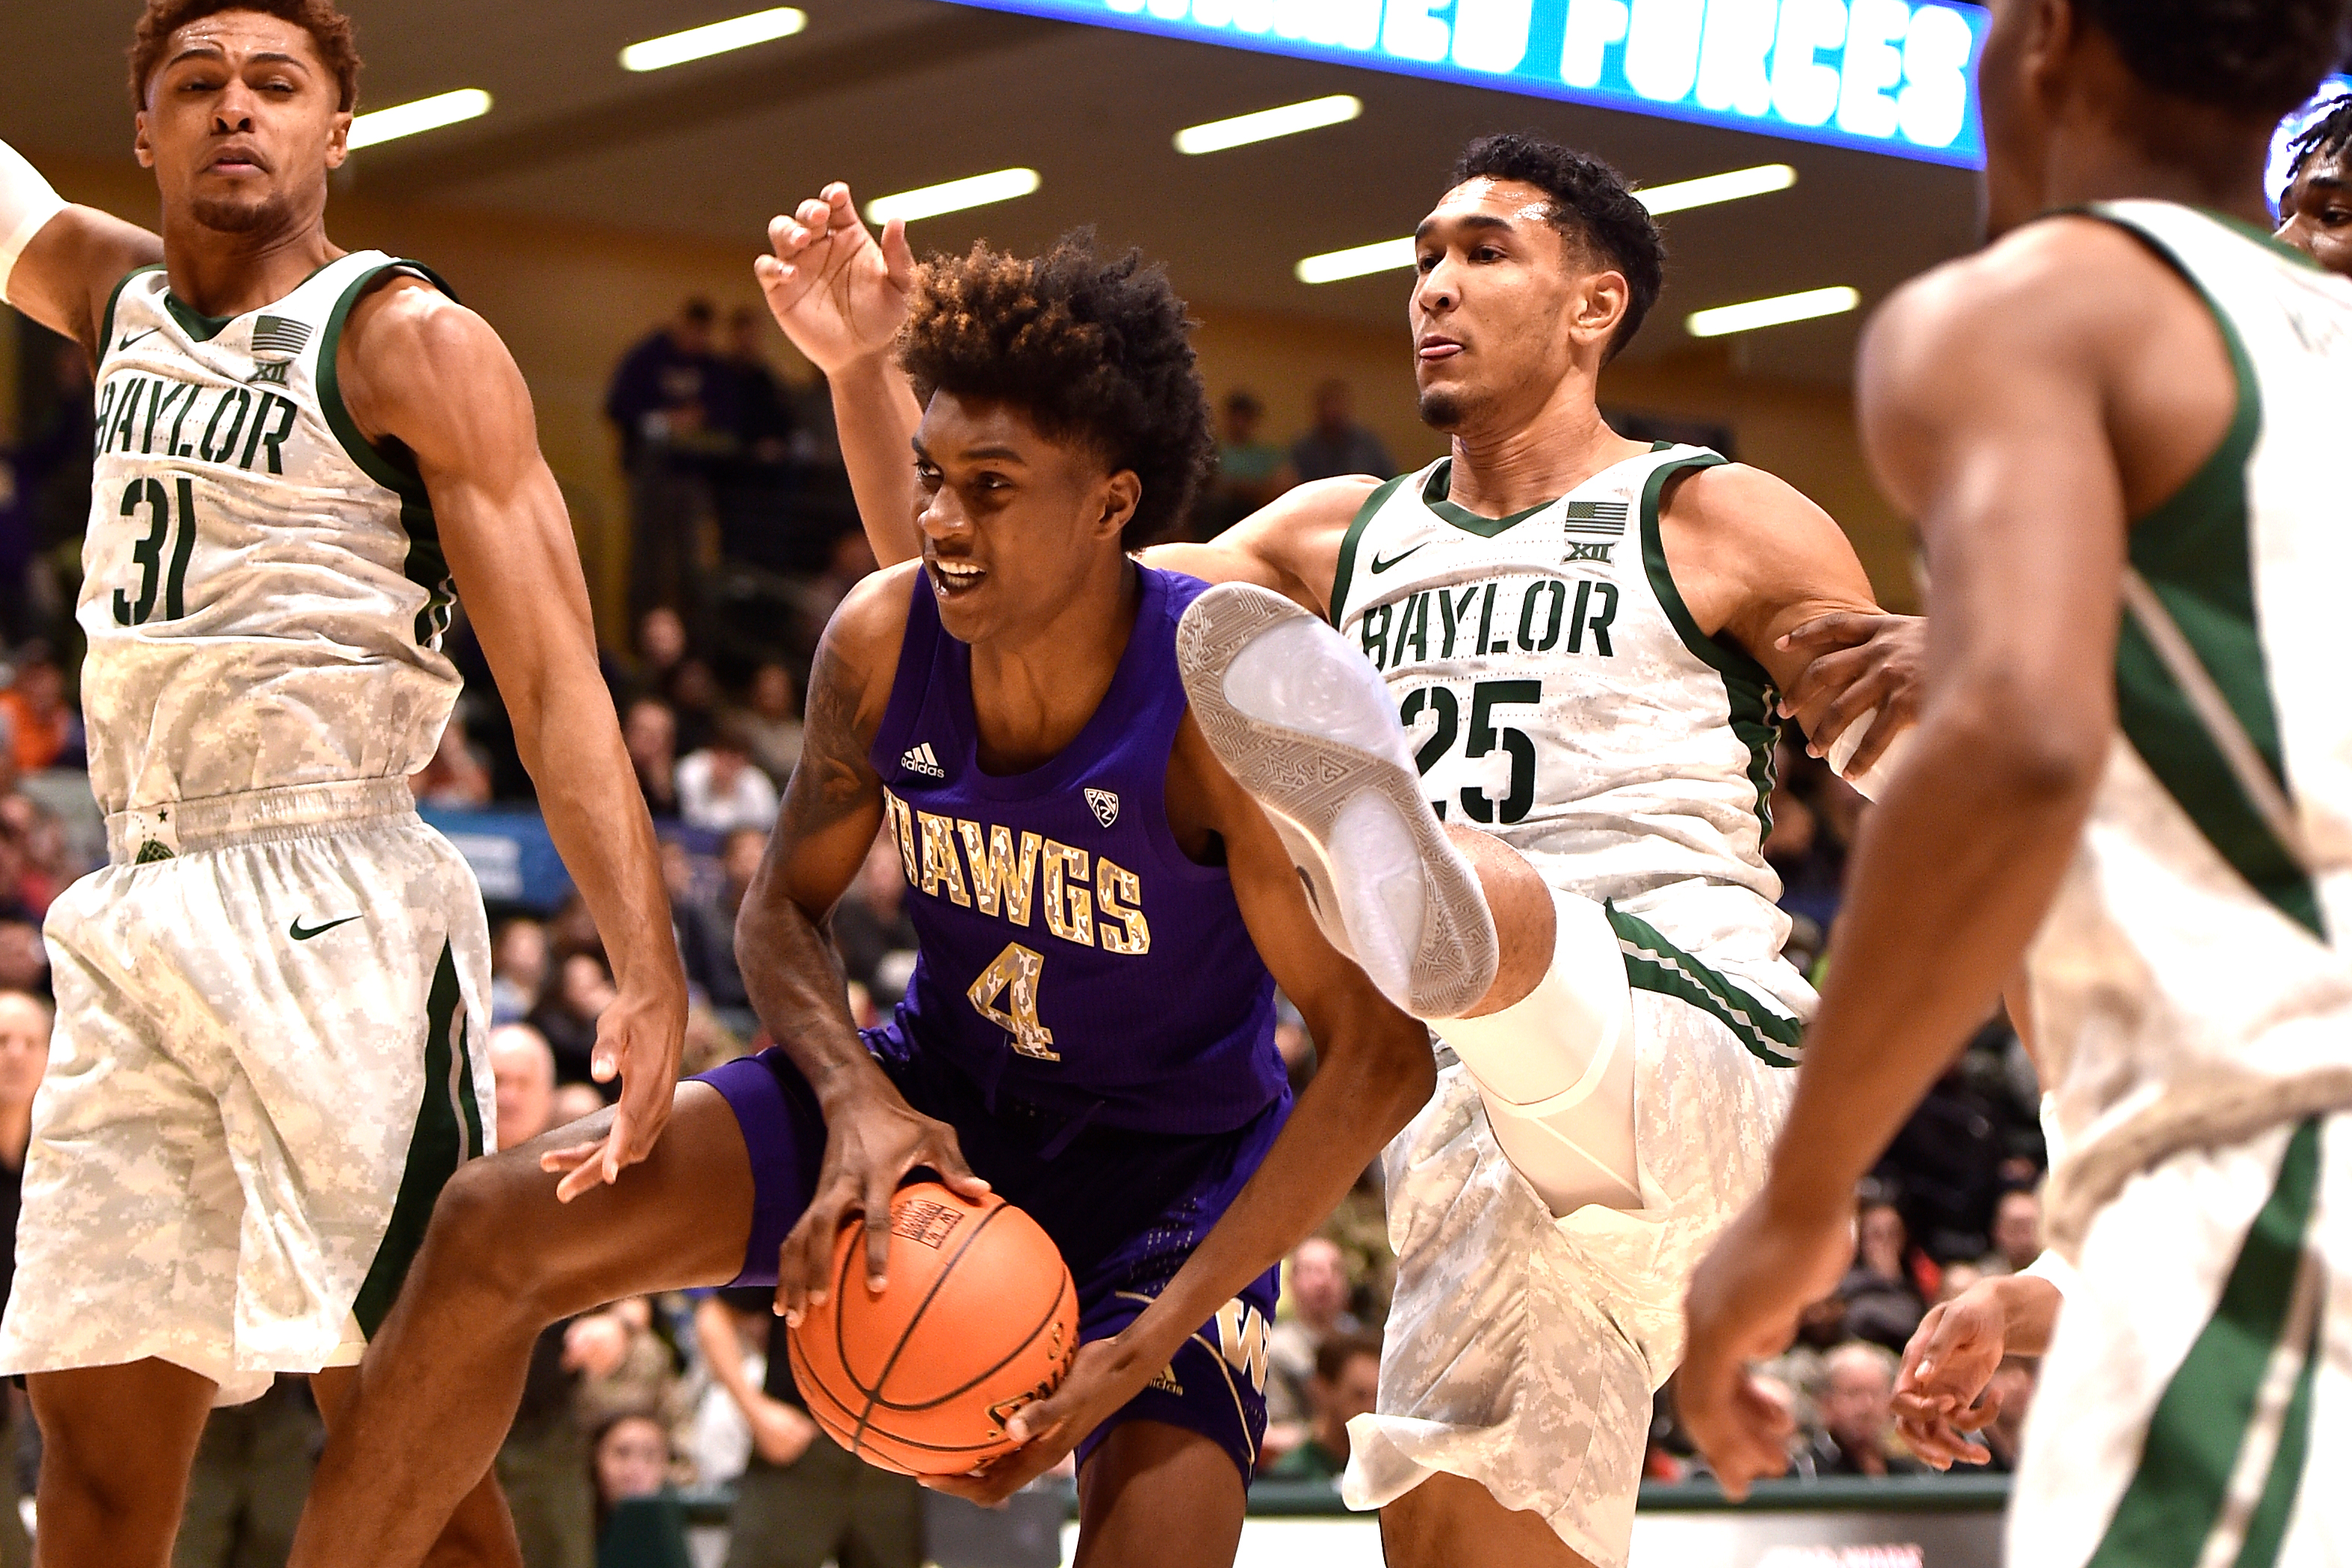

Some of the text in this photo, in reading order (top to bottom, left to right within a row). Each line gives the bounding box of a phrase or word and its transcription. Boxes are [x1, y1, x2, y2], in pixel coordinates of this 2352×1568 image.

[246, 358, 292, 386] XII
[94, 378, 298, 475] BAYLOR
[113, 477, 196, 626] 31
[1563, 541, 1616, 564] XII
[1362, 580, 1619, 673] BAYLOR
[901, 756, 945, 778] adidas
[1400, 680, 1542, 824] 25
[1087, 791, 1117, 814] PAC
[1096, 804, 1112, 821] 12
[884, 785, 1150, 954] DAWGS
[966, 942, 1060, 1061] 4
[1215, 1298, 1271, 1397] W
